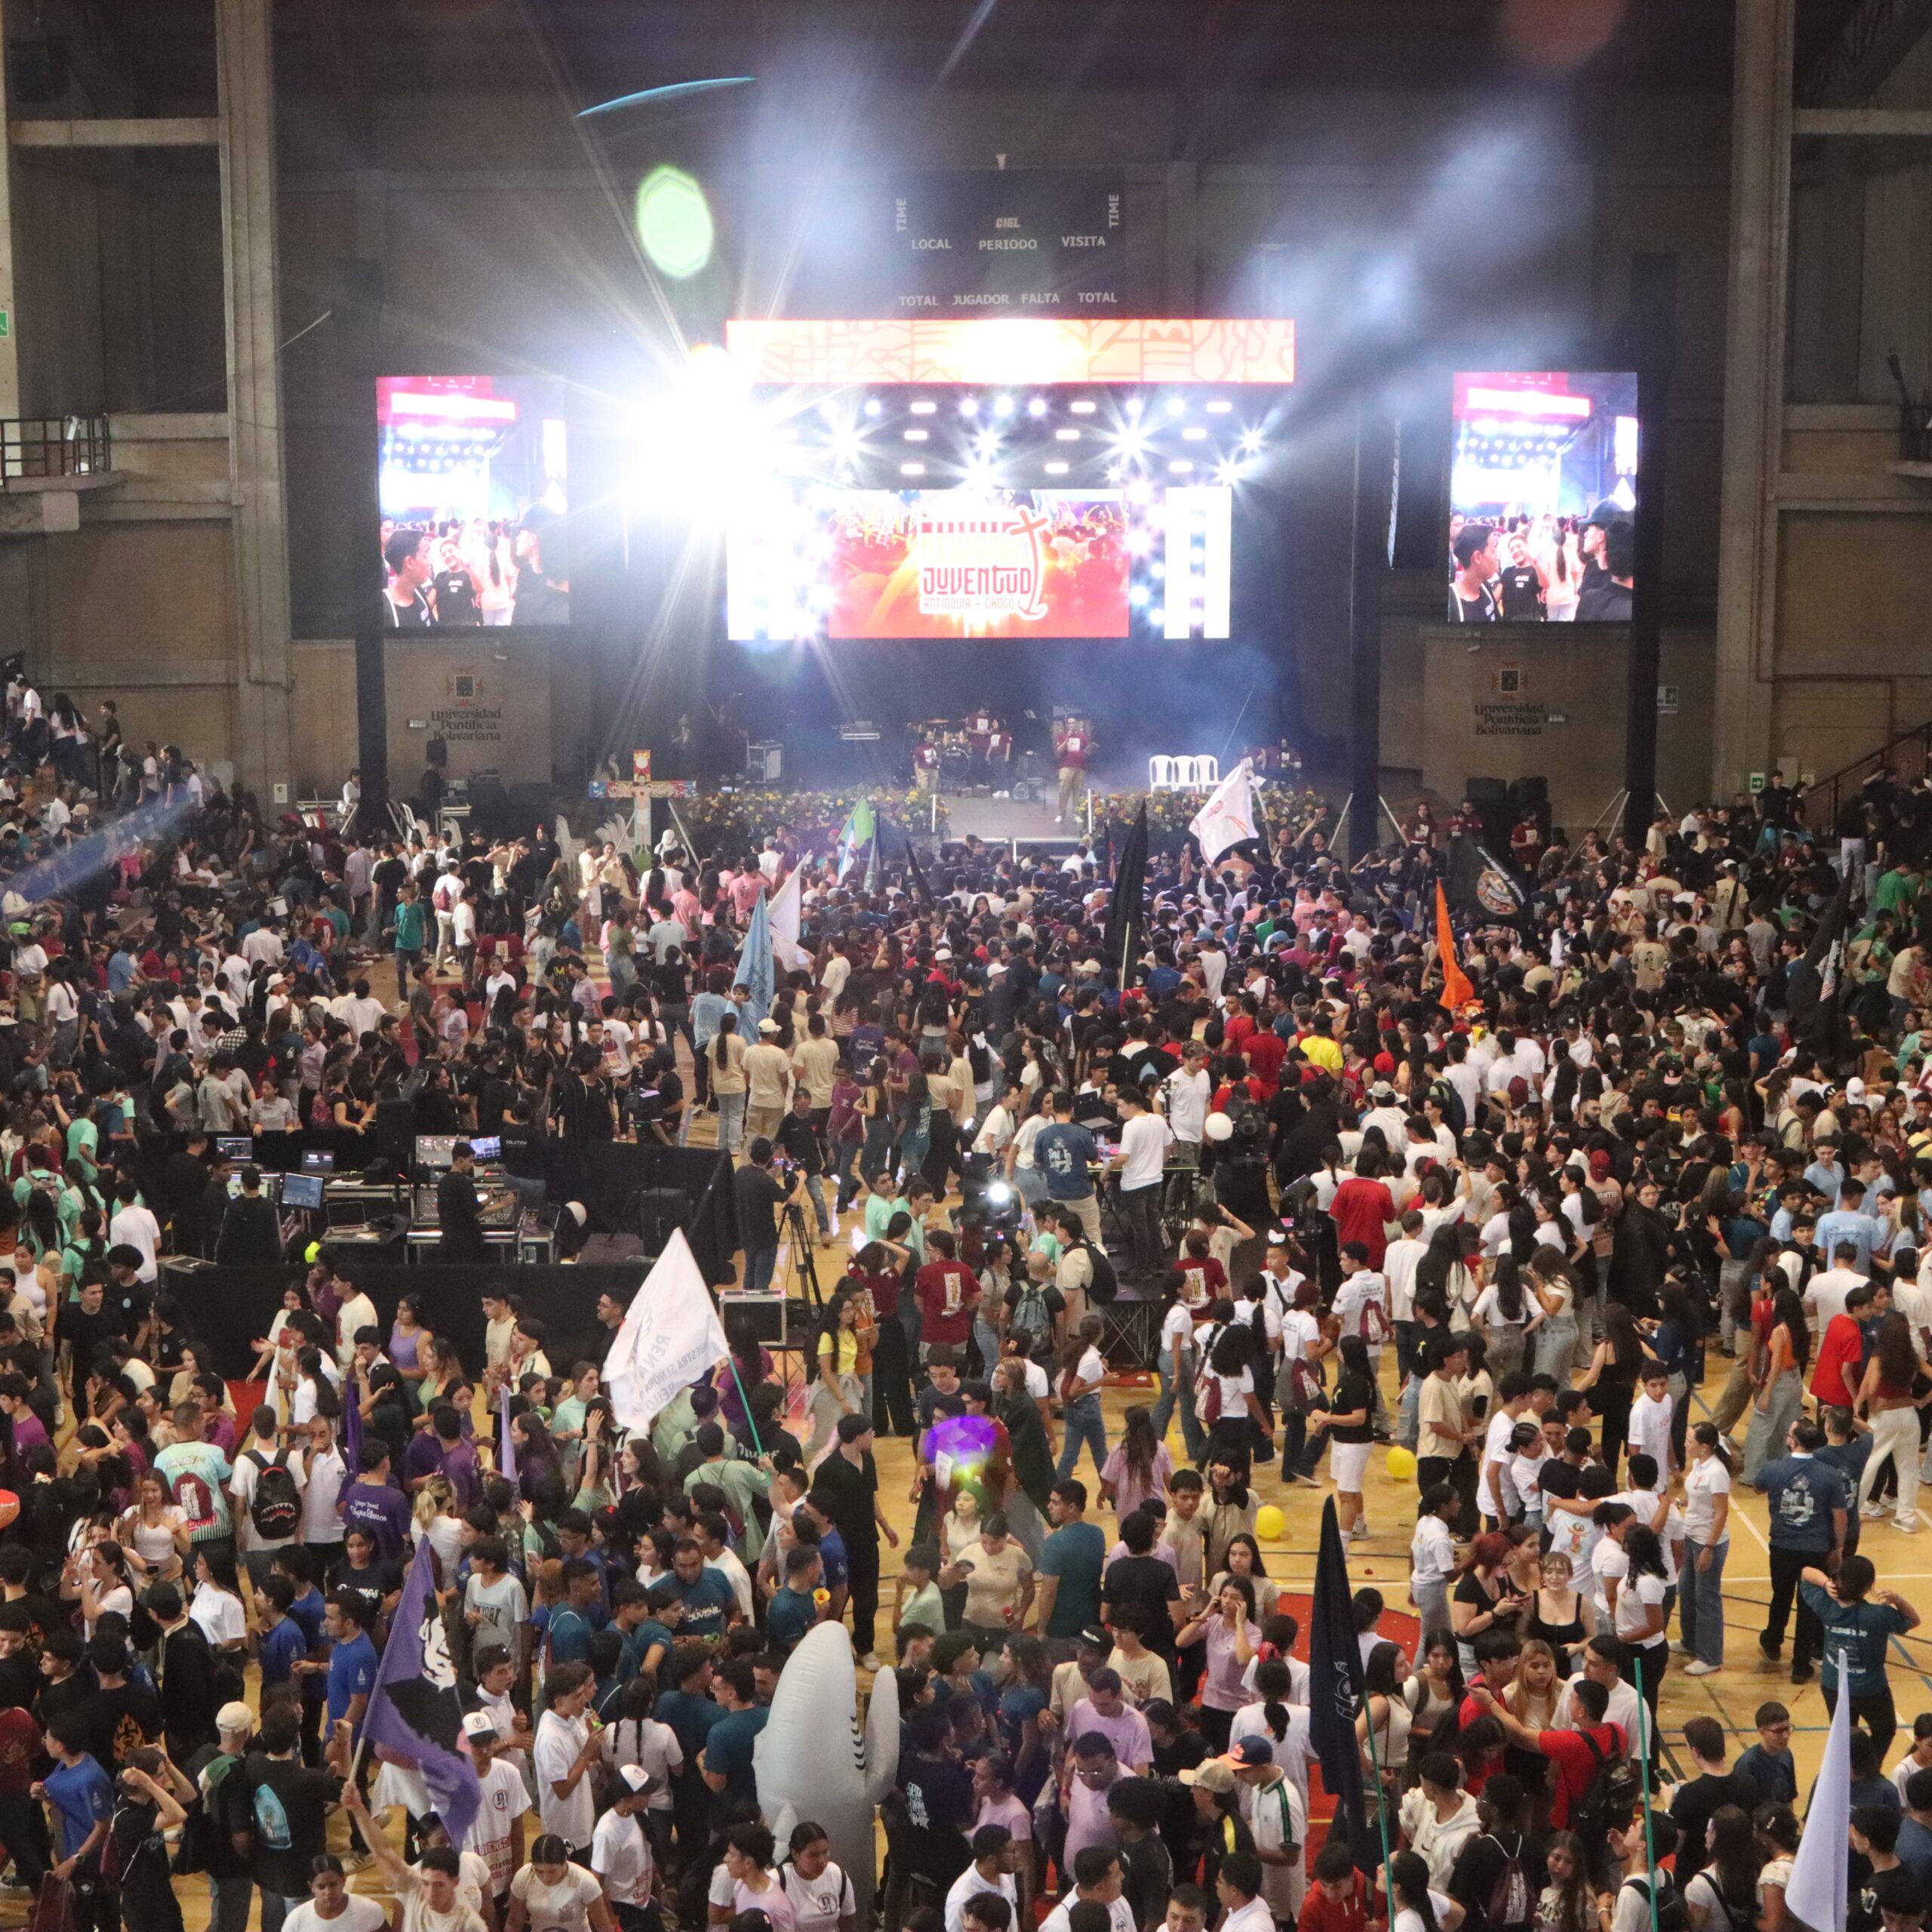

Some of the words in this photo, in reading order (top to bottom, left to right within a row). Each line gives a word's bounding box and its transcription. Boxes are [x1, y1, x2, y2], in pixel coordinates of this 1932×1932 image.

[897, 198, 906, 233] TIME
[1109, 194, 1119, 228] TIME
[912, 238, 952, 249] LOCAL
[979, 239, 1038, 250] PERIODO
[1061, 235, 1106, 247] VISITA
[900, 296, 939, 306] TOTAL
[952, 294, 1010, 306] JUGADOR
[1021, 293, 1060, 304] FALTA
[1078, 292, 1118, 303] TOTAL
[431, 708, 501, 721] Universidad
[1475, 703, 1544, 715] Universidad
[1475, 724, 1542, 736] Bolivariana
[482, 1607, 501, 1628] YORK
